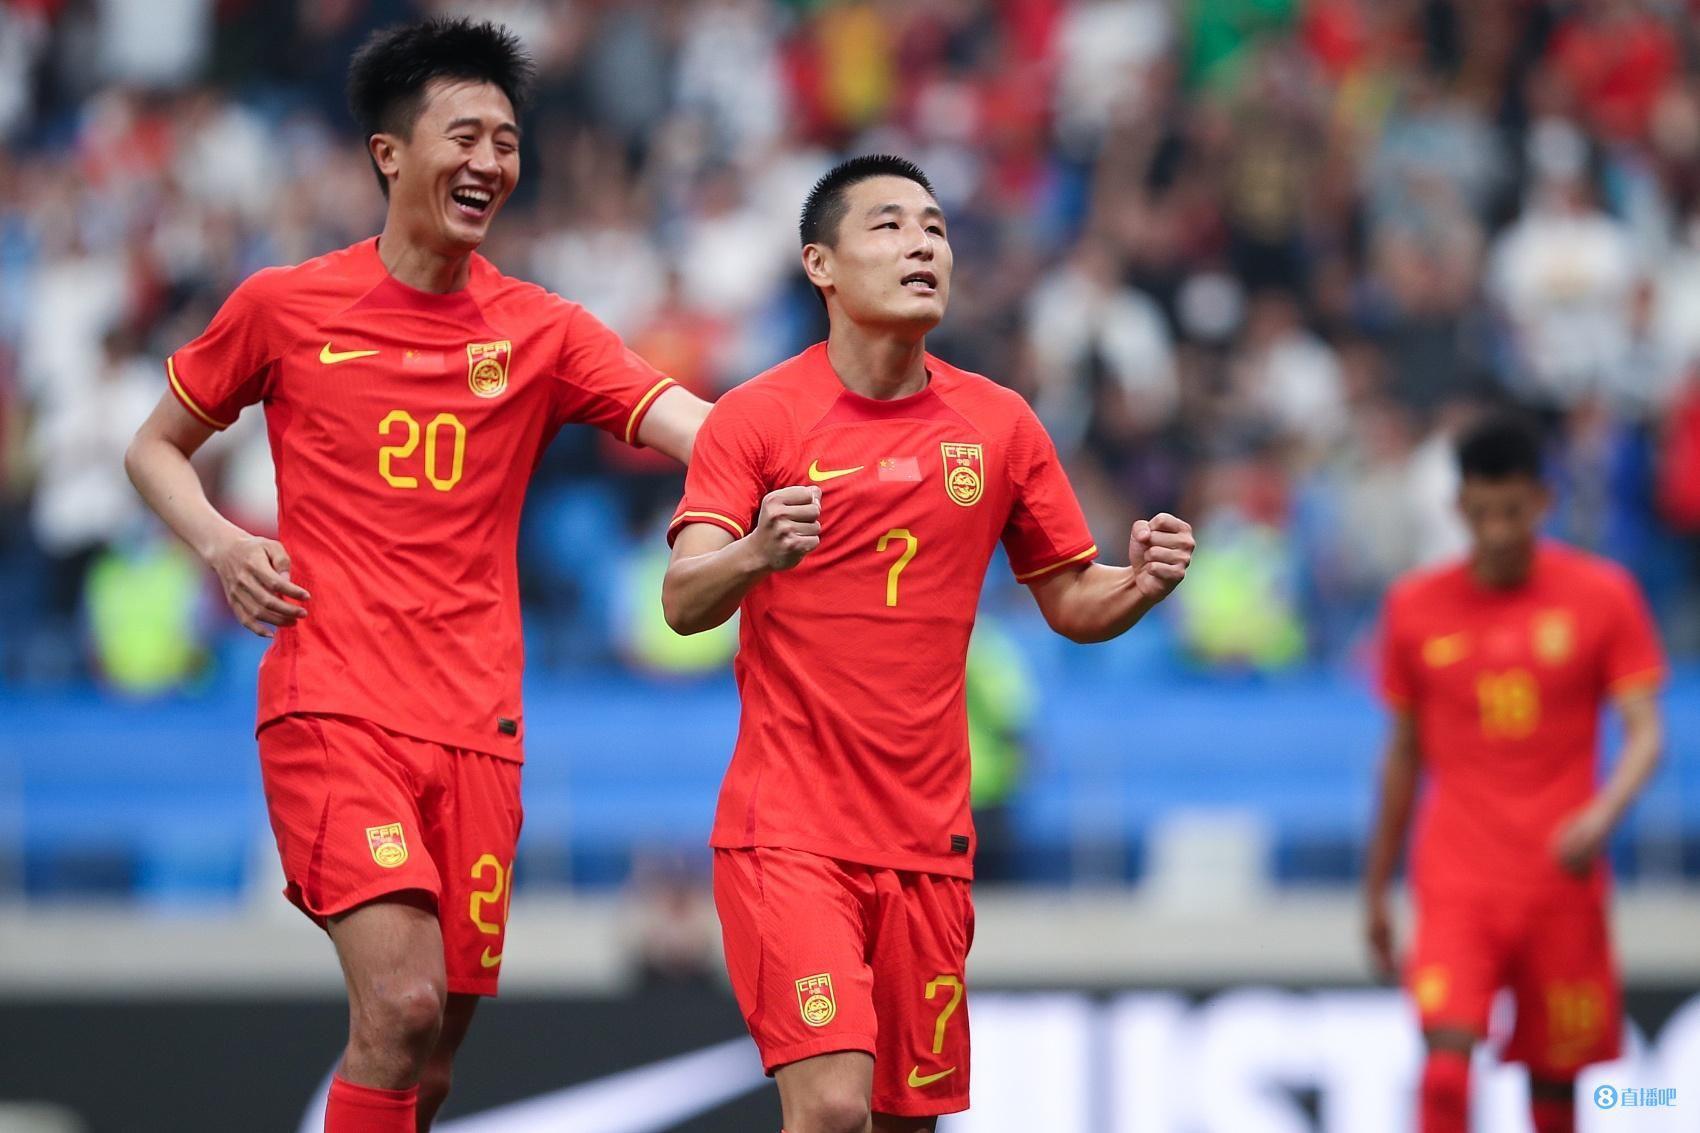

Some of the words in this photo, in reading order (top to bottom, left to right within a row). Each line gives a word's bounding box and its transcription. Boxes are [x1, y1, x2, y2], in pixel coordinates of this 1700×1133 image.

[379, 410, 466, 491] 20
[945, 446, 979, 459] CFA
[876, 529, 918, 607] 7
[370, 826, 400, 839] CFA
[799, 976, 828, 991] CFA
[925, 975, 963, 1054] 7
